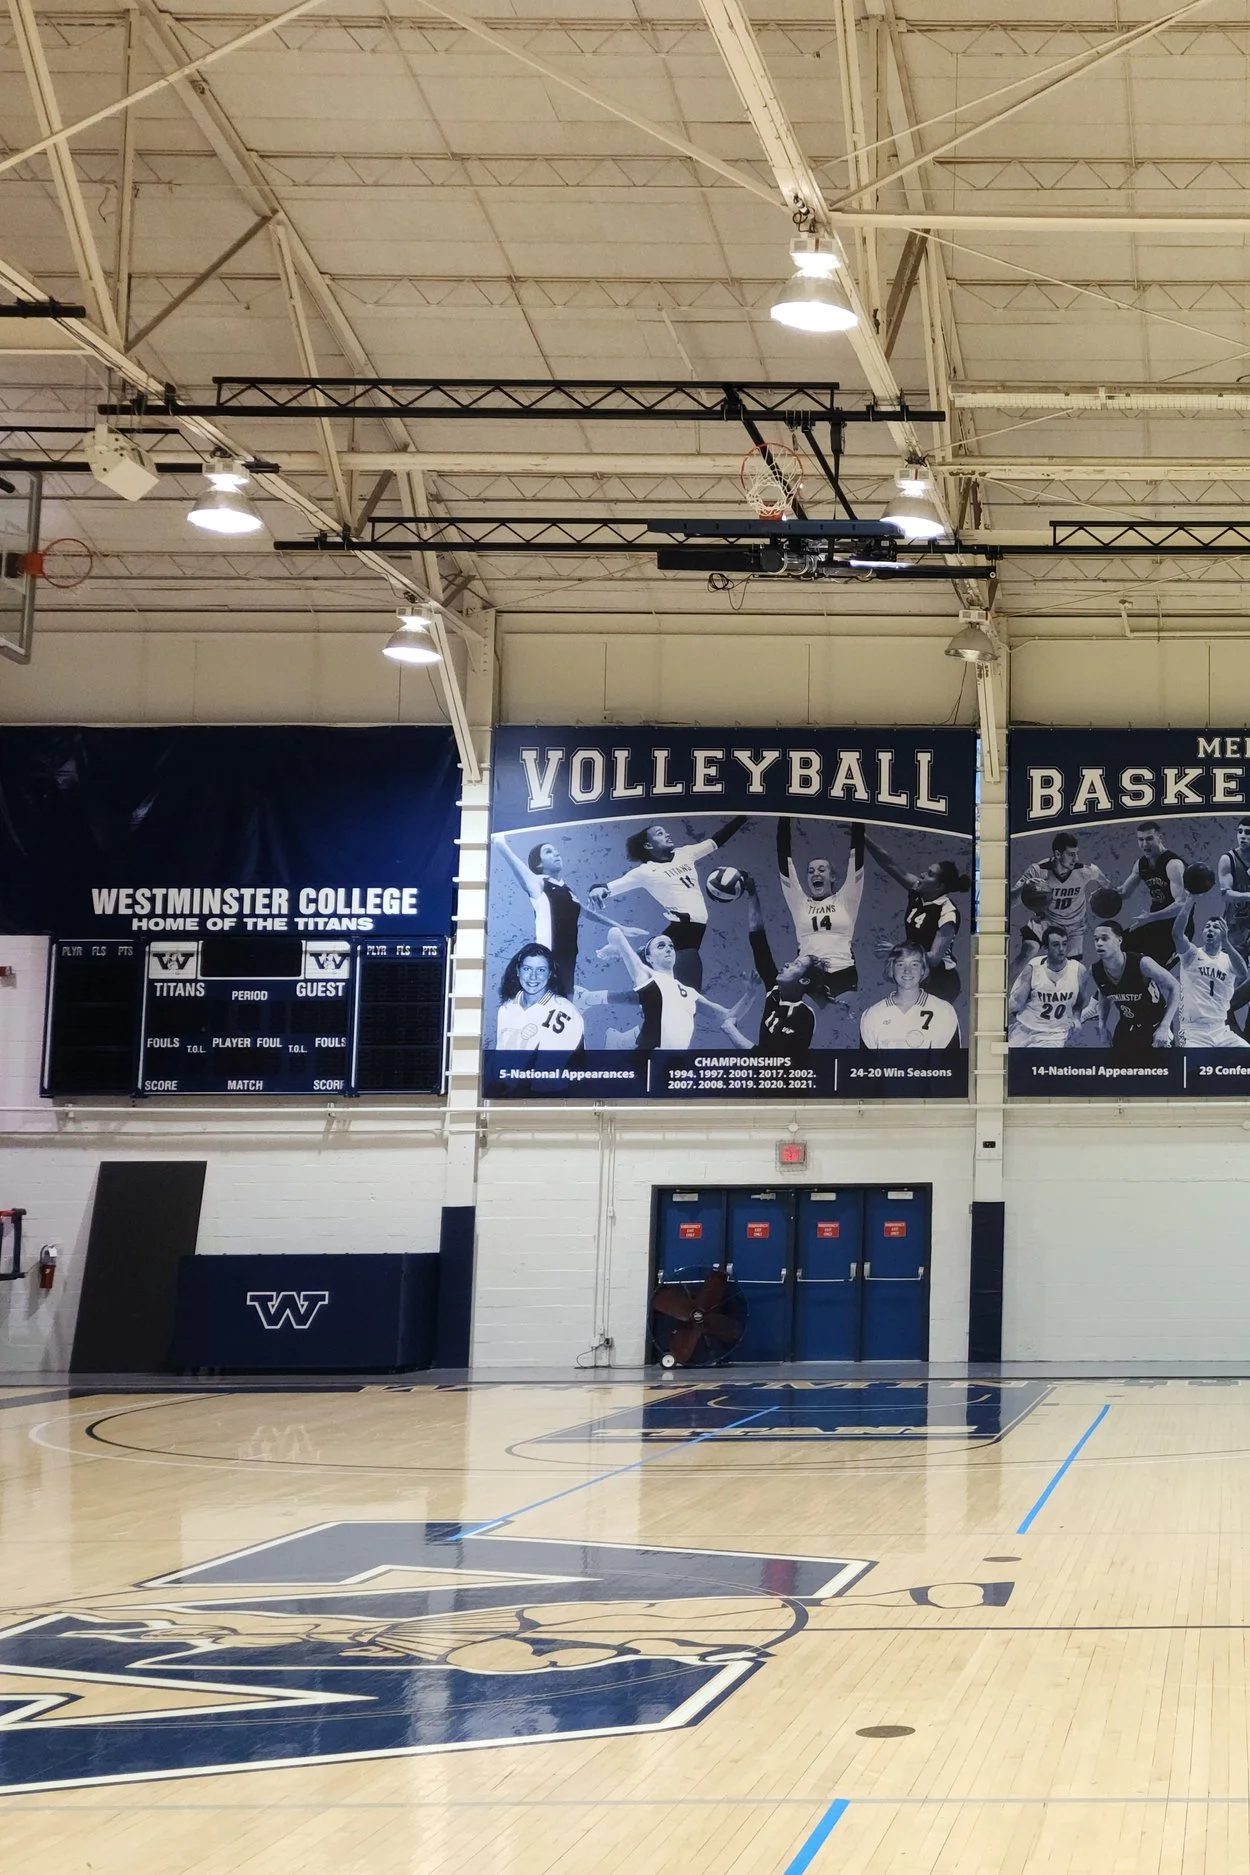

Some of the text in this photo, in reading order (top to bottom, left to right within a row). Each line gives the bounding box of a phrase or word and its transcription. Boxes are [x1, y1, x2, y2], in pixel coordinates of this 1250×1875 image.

[519, 746, 949, 816] VOLLEYBALL
[664, 863, 693, 878] TITANS
[1051, 887, 1081, 897] ITANS
[91, 887, 419, 915] WESTMINSTER COLLEGE
[807, 904, 836, 914] TITANS
[131, 917, 375, 931] HOME OF THE TITANS
[811, 914, 832, 932] 14
[906, 908, 927, 929] 14
[62, 946, 133, 956] PLYR FLS PTS
[366, 945, 438, 956] PLYR FLS PTS
[154, 982, 205, 997] TITANS
[296, 982, 346, 997] GUEST
[231, 990, 268, 1001] PERIOD
[1040, 1004, 1067, 1020] 20
[541, 1008, 571, 1034] 15
[920, 1010, 934, 1031] 7
[147, 1037, 180, 1048] FOULS
[212, 1037, 283, 1048] PLAYER FOUL
[314, 1037, 347, 1048] FOULS
[187, 1045, 207, 1053] T.O.L.
[288, 1045, 308, 1053] T.O.L.
[694, 1056, 792, 1067] CHAMPIONSHIPS
[499, 1068, 635, 1081] 5-National Appearances
[668, 1069, 817, 1079] 1994. 1997. 2001. 2017. 2002.
[850, 1067, 952, 1078] 24-20 Win Seasons
[1031, 1065, 1169, 1078] 14-National Appearances
[1199, 1065, 1214, 1076] 29
[144, 1080, 178, 1091] SCORE
[227, 1080, 264, 1091] MATCH
[668, 1080, 817, 1090] 2007. 2008. 2019. 2020. 2021.
[246, 1291, 330, 1330] W
